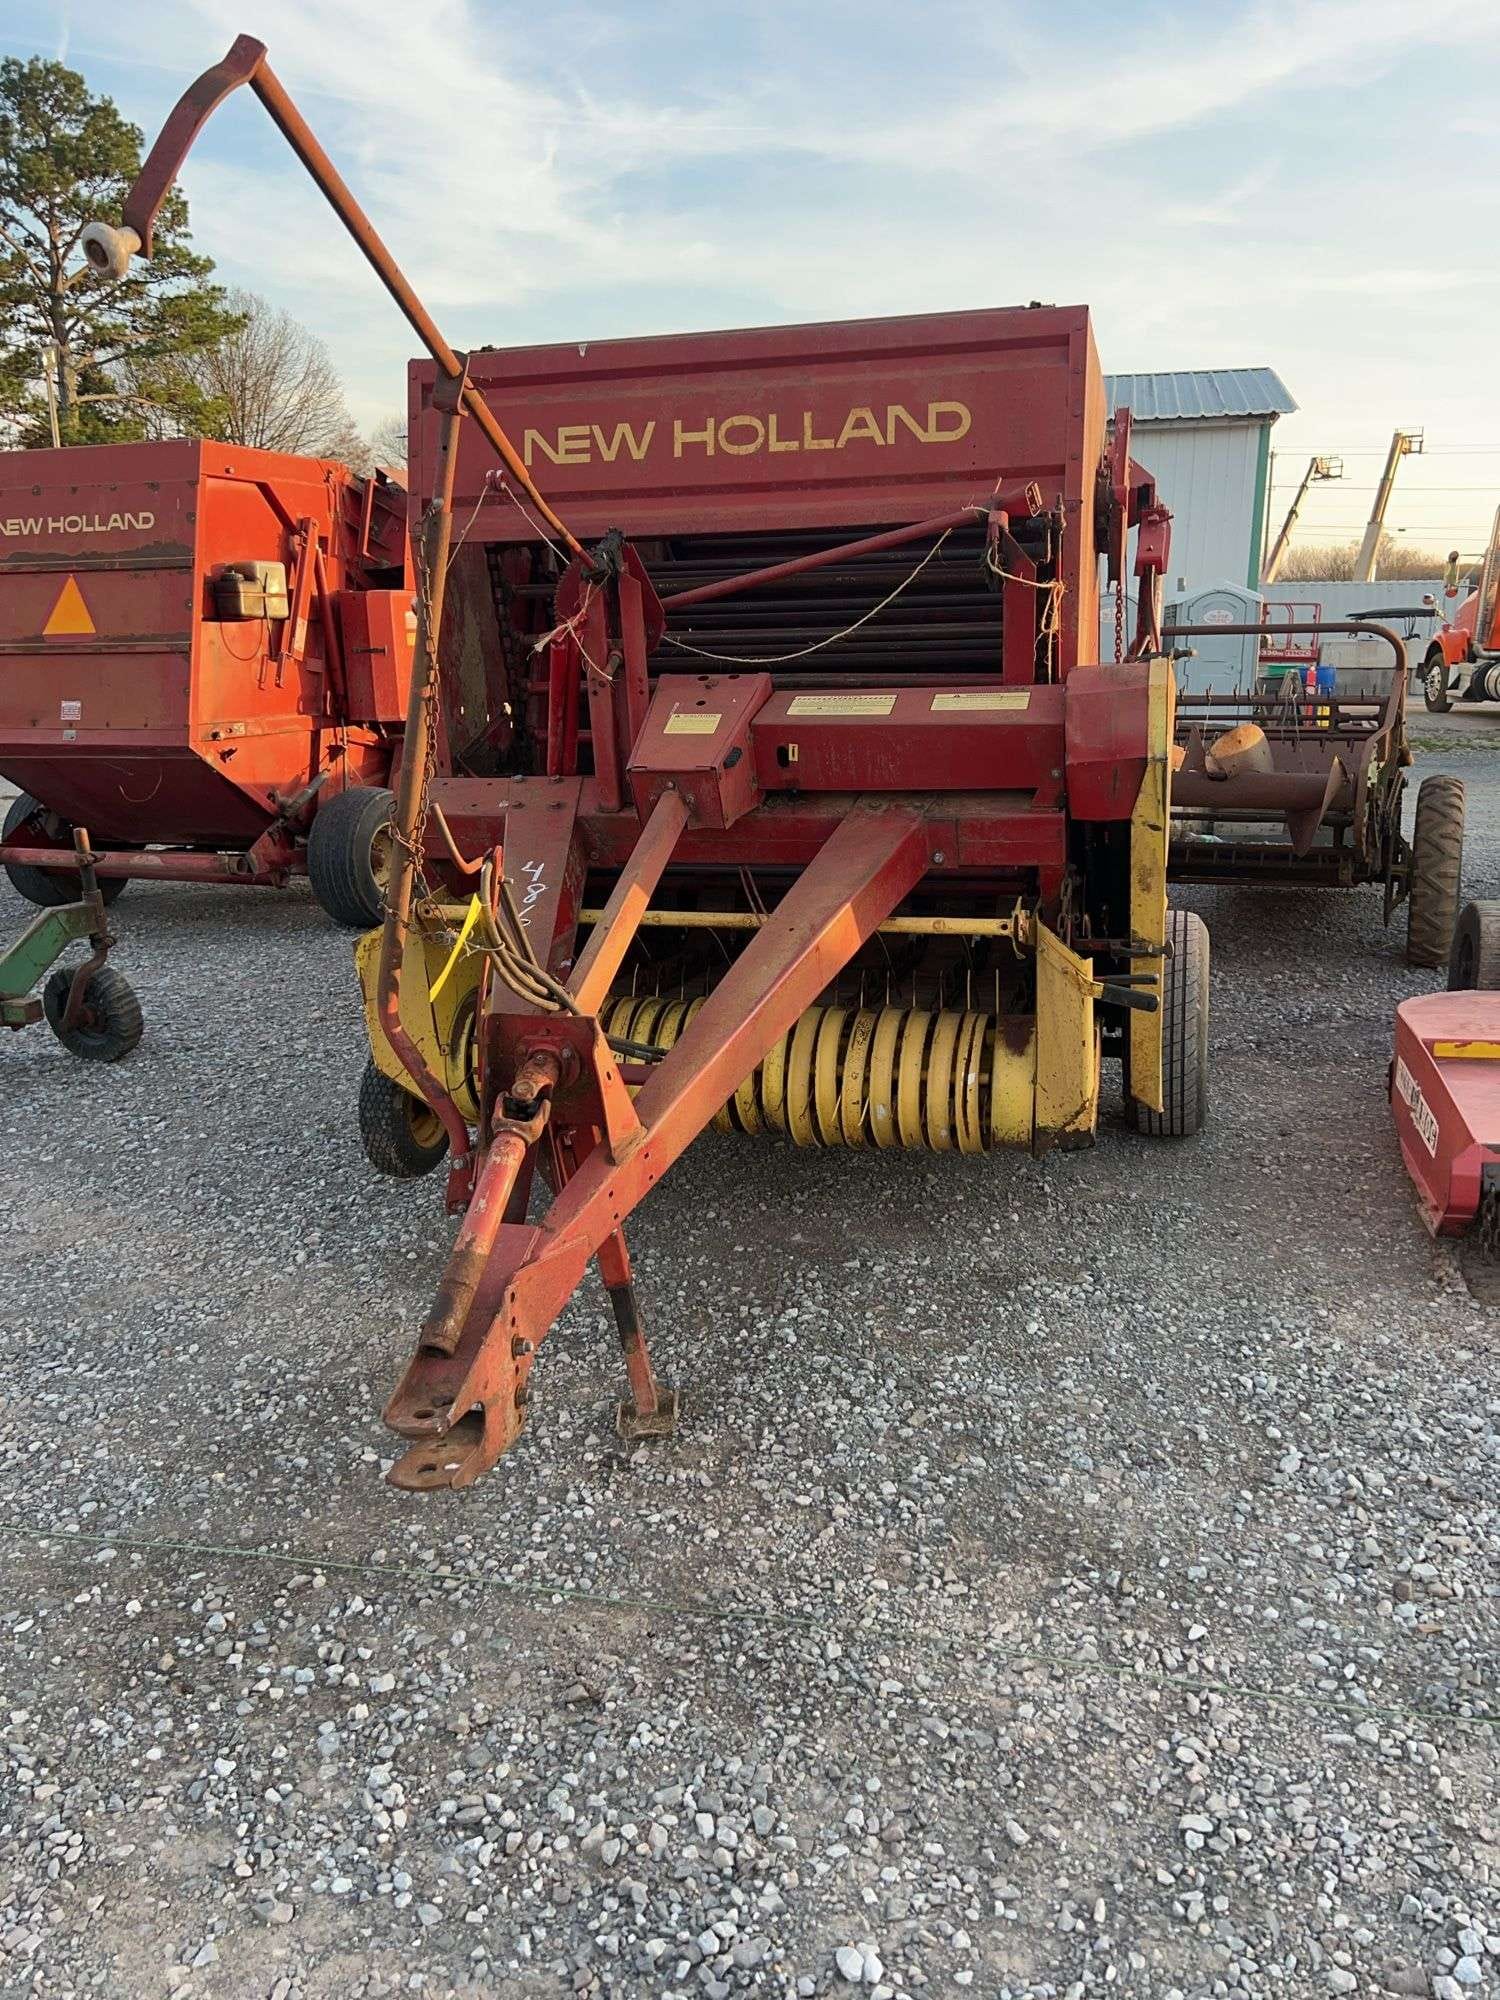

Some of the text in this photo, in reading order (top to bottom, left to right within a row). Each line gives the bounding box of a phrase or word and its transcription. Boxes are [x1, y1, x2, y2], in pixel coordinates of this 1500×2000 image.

[524, 400, 972, 466] NEW HOLLAND
[48, 511, 155, 534] HOLLAND
